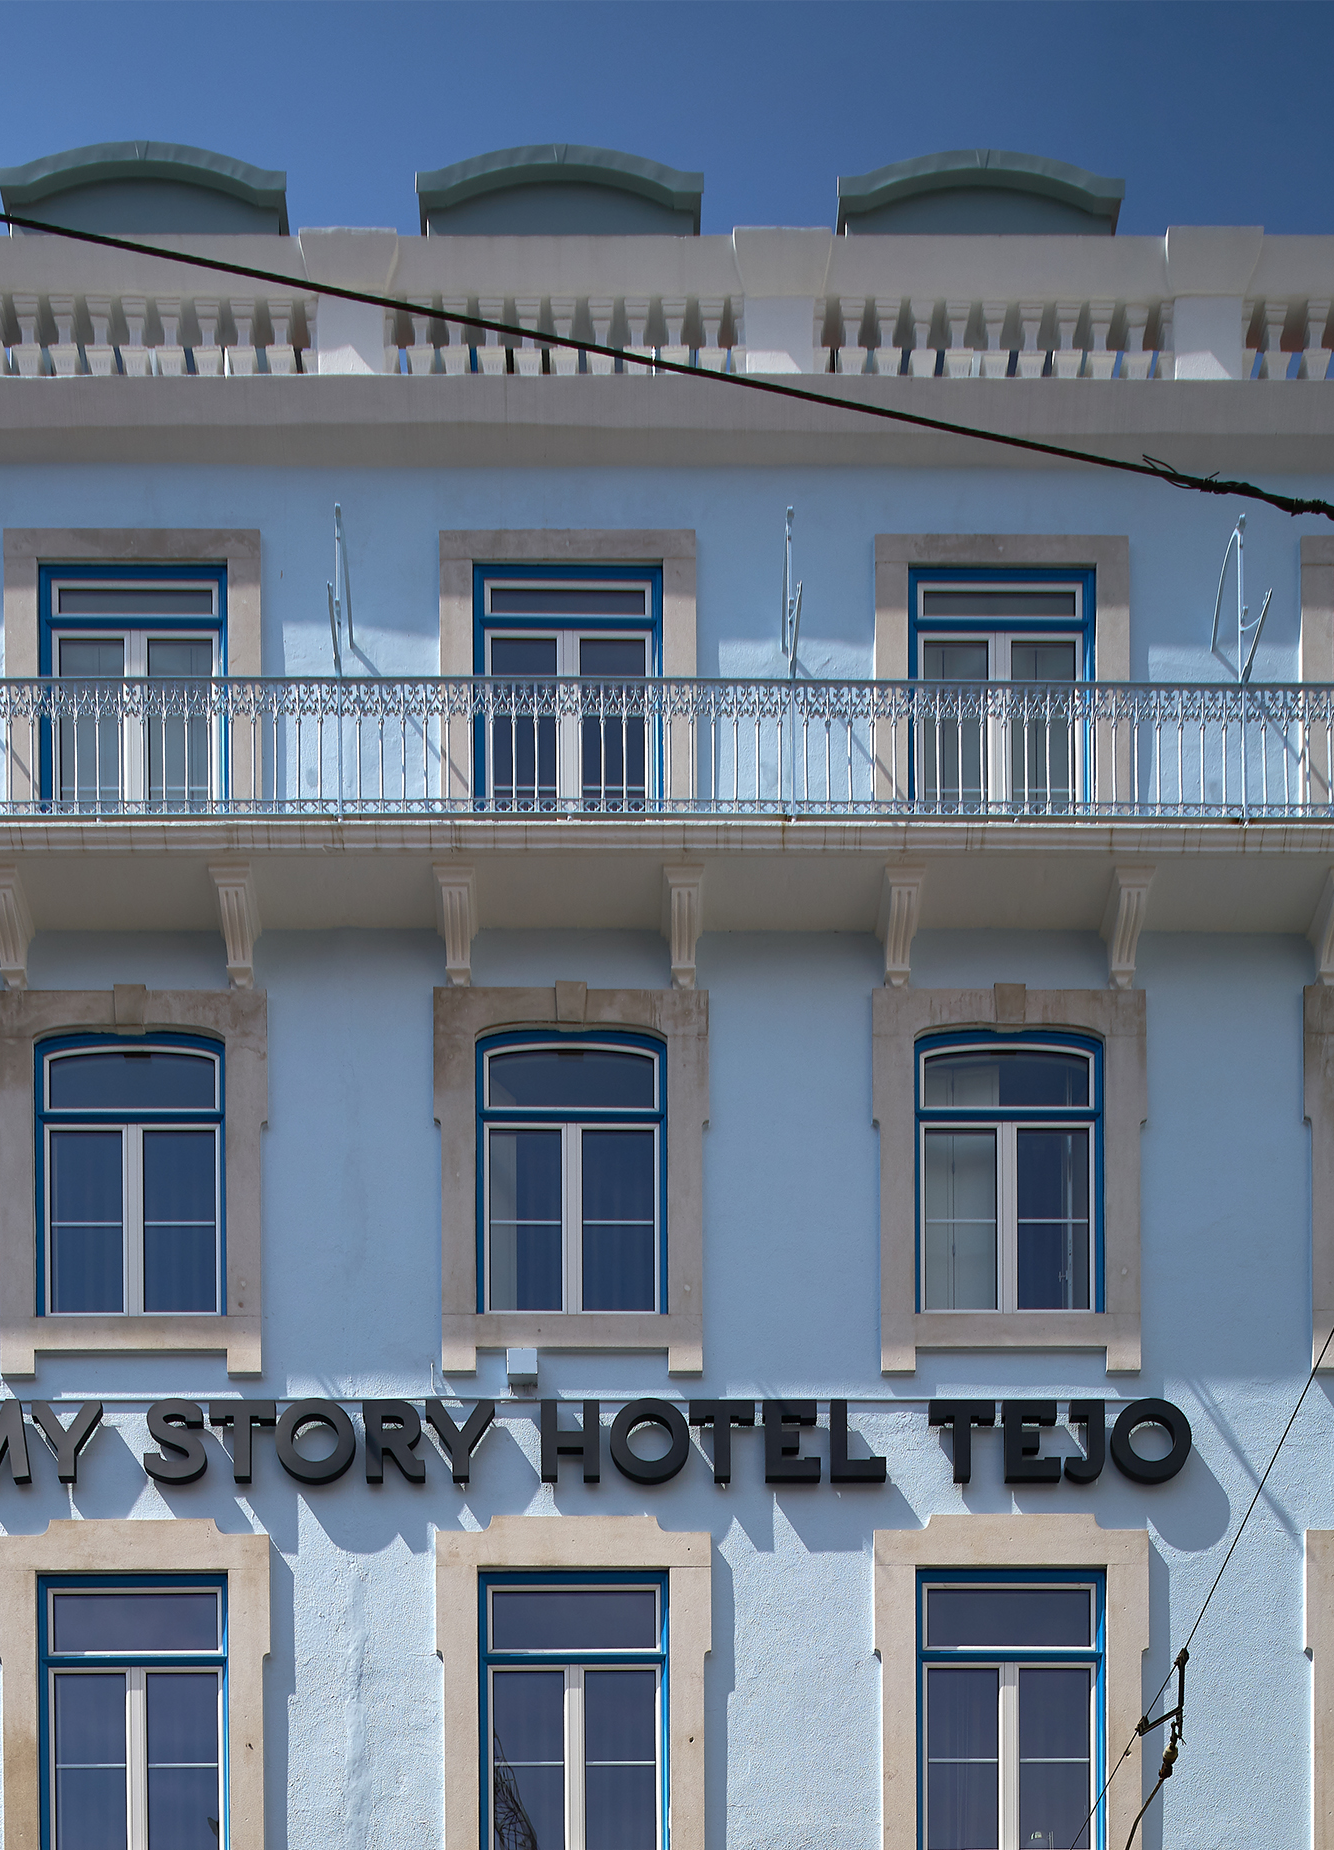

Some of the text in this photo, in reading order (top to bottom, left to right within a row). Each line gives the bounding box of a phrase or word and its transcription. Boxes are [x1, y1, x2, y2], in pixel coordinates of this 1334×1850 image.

[144, 1398, 495, 1485] STORY
[541, 1398, 886, 1484] HOTEL
[929, 1398, 1192, 1484] TEJO
